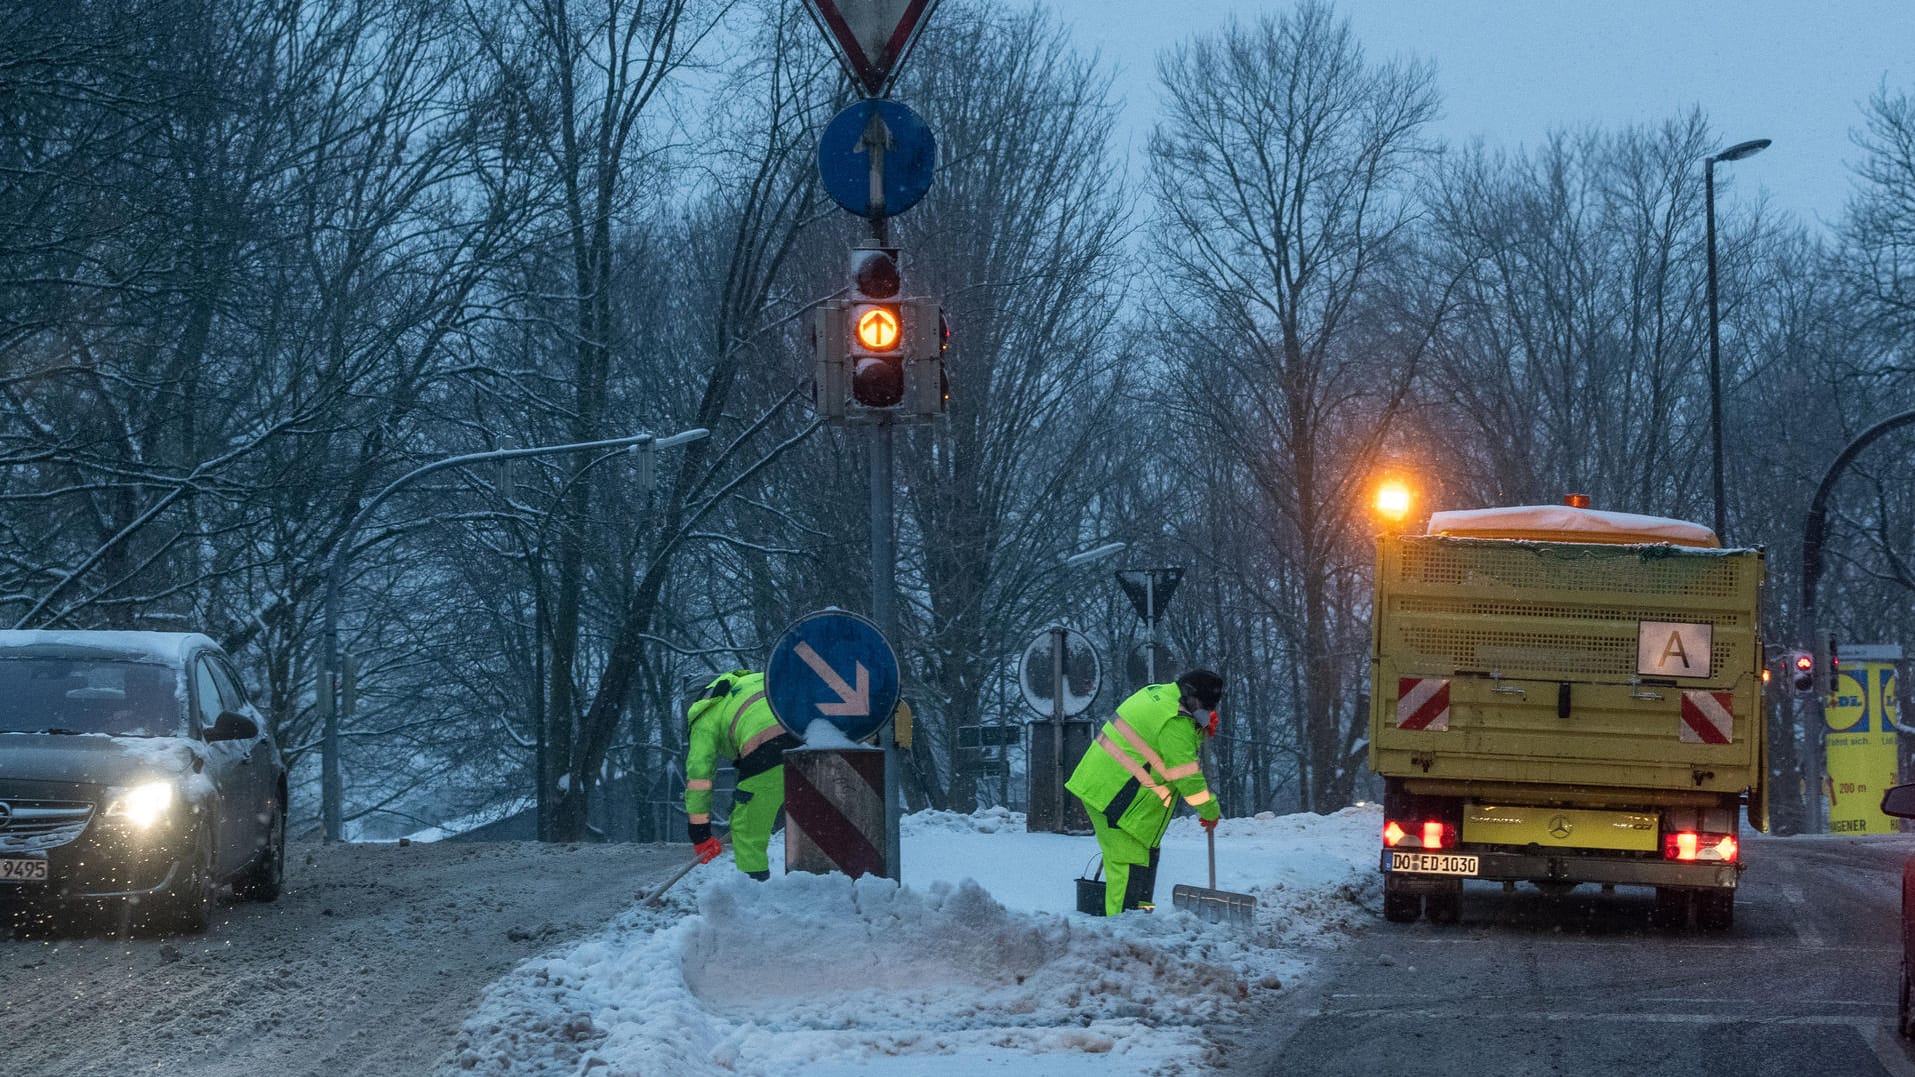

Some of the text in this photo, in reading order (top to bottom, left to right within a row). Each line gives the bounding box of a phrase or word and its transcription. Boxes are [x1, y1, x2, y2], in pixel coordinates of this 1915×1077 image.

[1658, 630, 1690, 668] A
[1839, 782, 1867, 794] 200 m
[3, 861, 46, 878] 9495
[1394, 854, 1411, 870] DO
